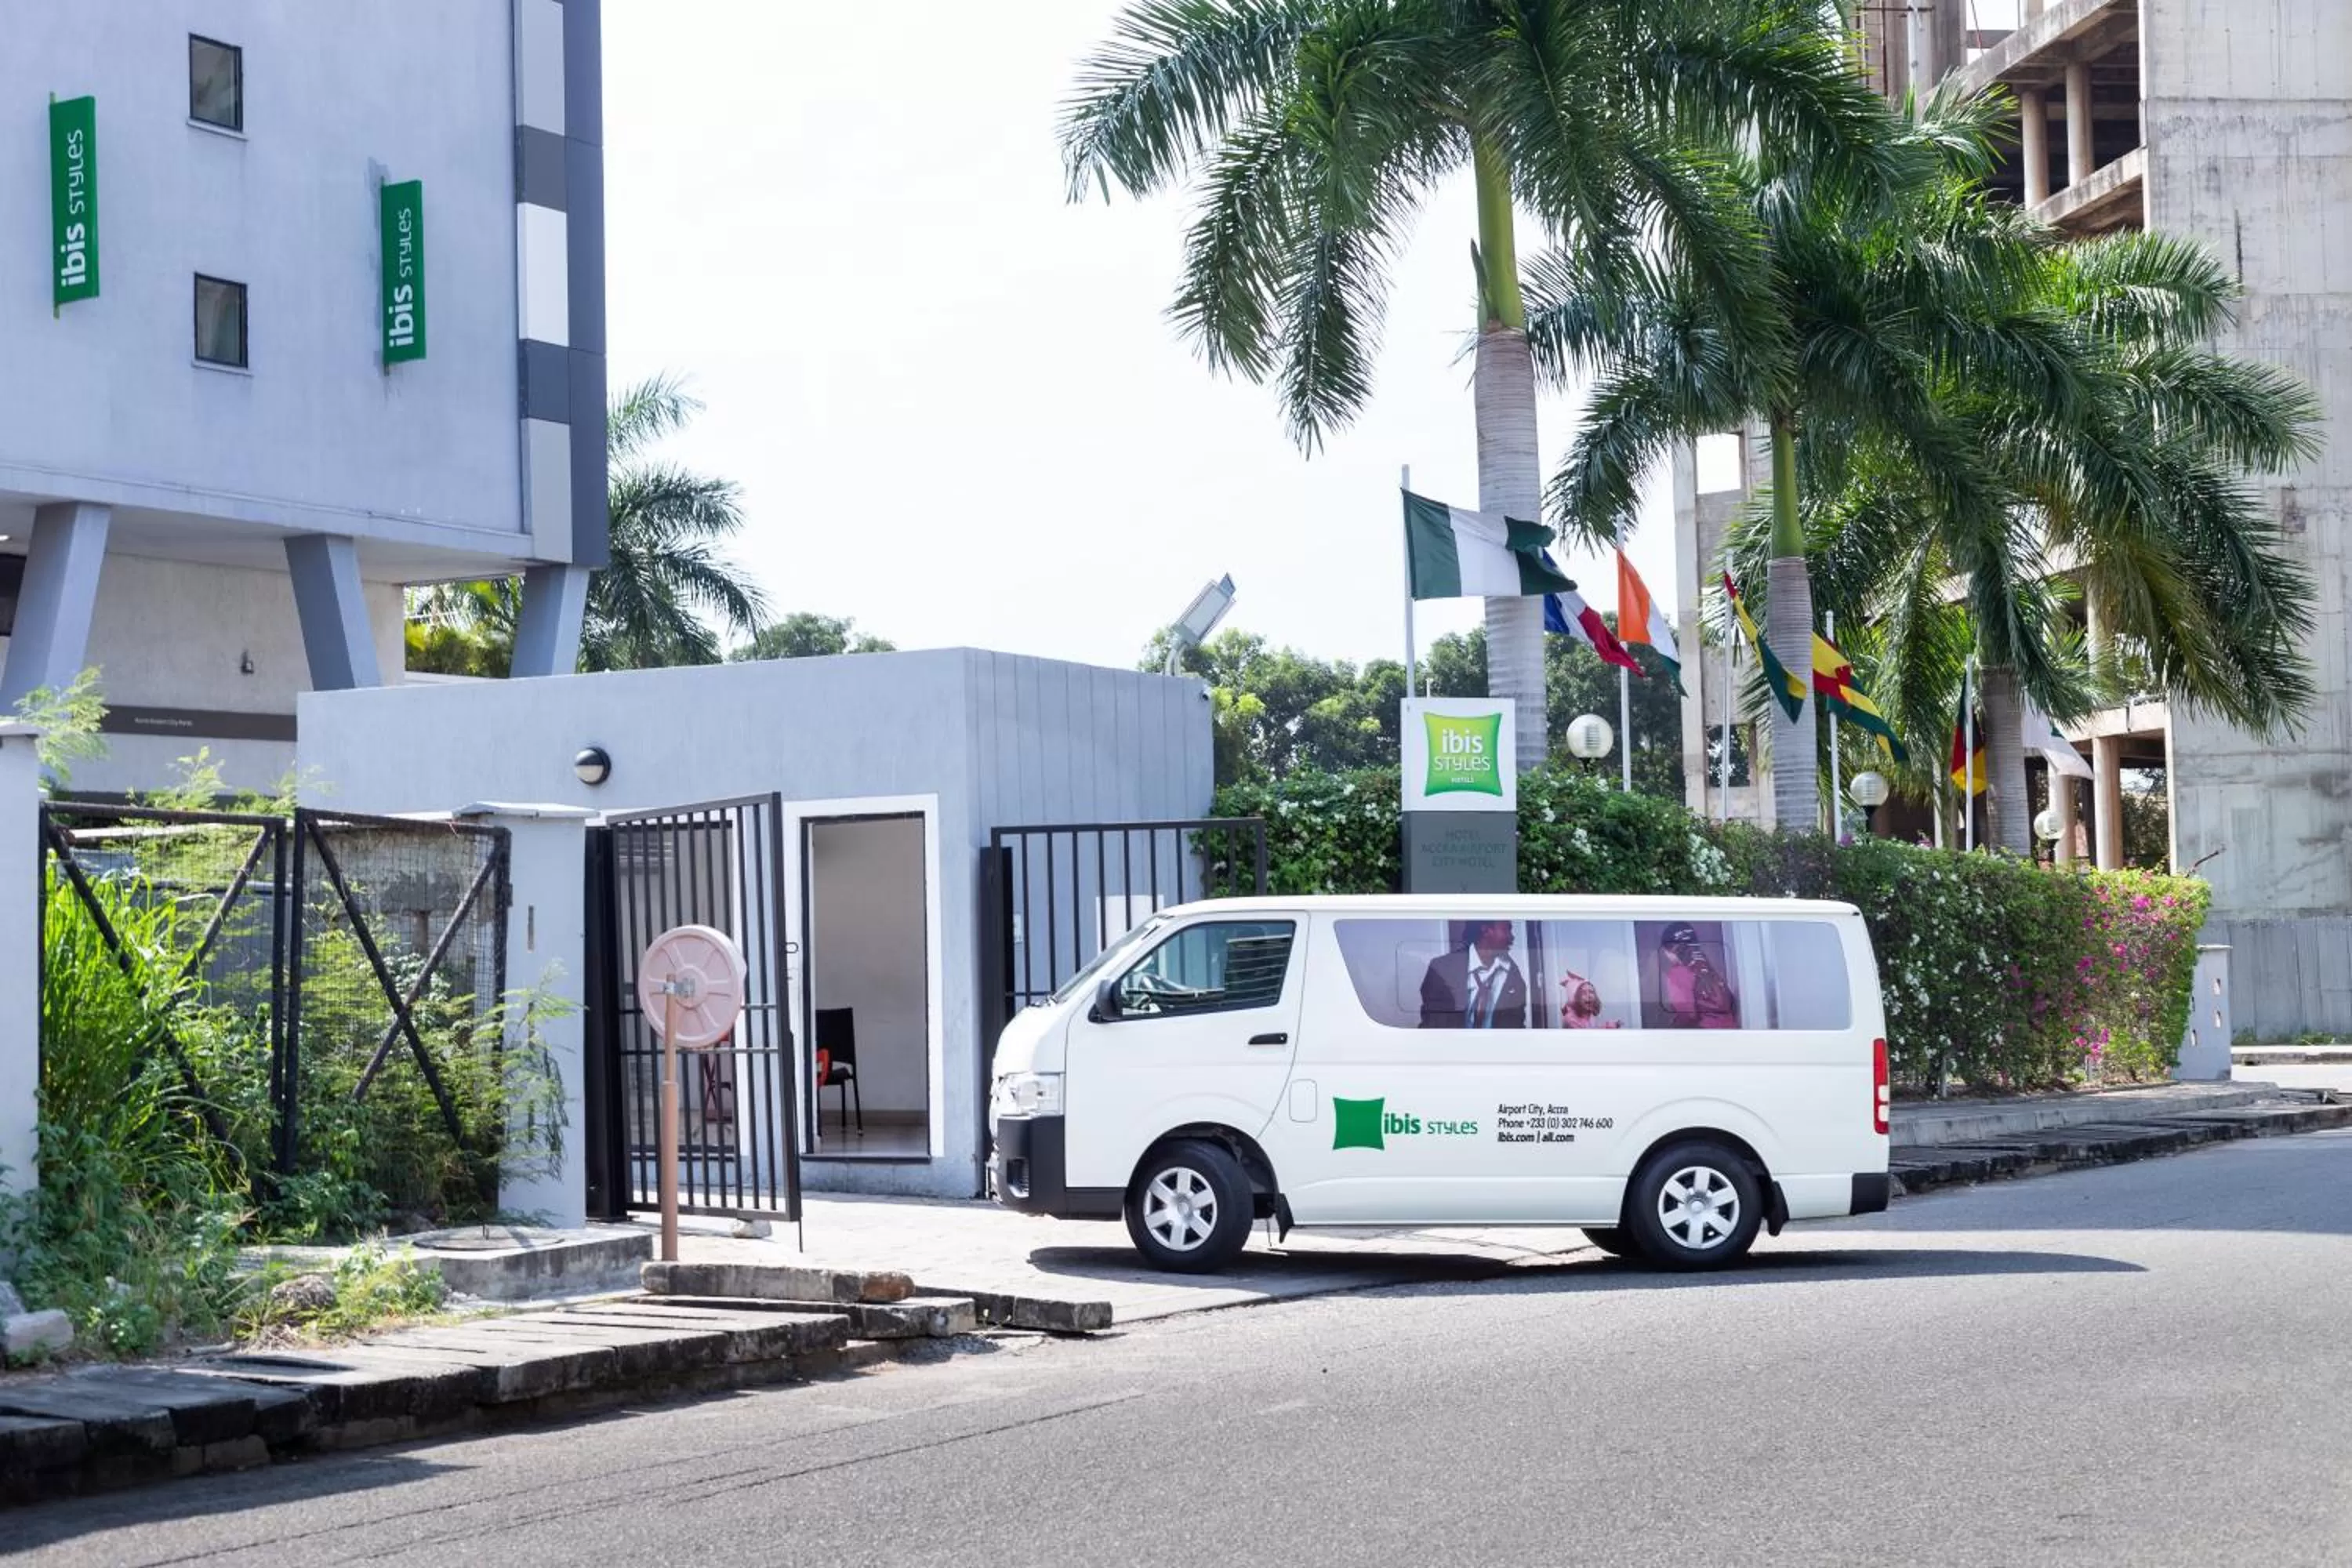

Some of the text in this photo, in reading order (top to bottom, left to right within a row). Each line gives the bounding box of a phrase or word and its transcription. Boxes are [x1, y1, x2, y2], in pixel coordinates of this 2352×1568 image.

[60, 222, 86, 287] ibis
[388, 284, 414, 347] ibis
[1442, 728, 1483, 753] ibis
[1497, 1103, 1569, 1116] Airport City, Accra
[1384, 1112, 1421, 1134] ibis
[1497, 1118, 1525, 1128] Phone
[1547, 1117, 1559, 1129] (0)
[1562, 1118, 1577, 1128] 302
[1579, 1118, 1594, 1129] 746
[1595, 1118, 1614, 1129] 600
